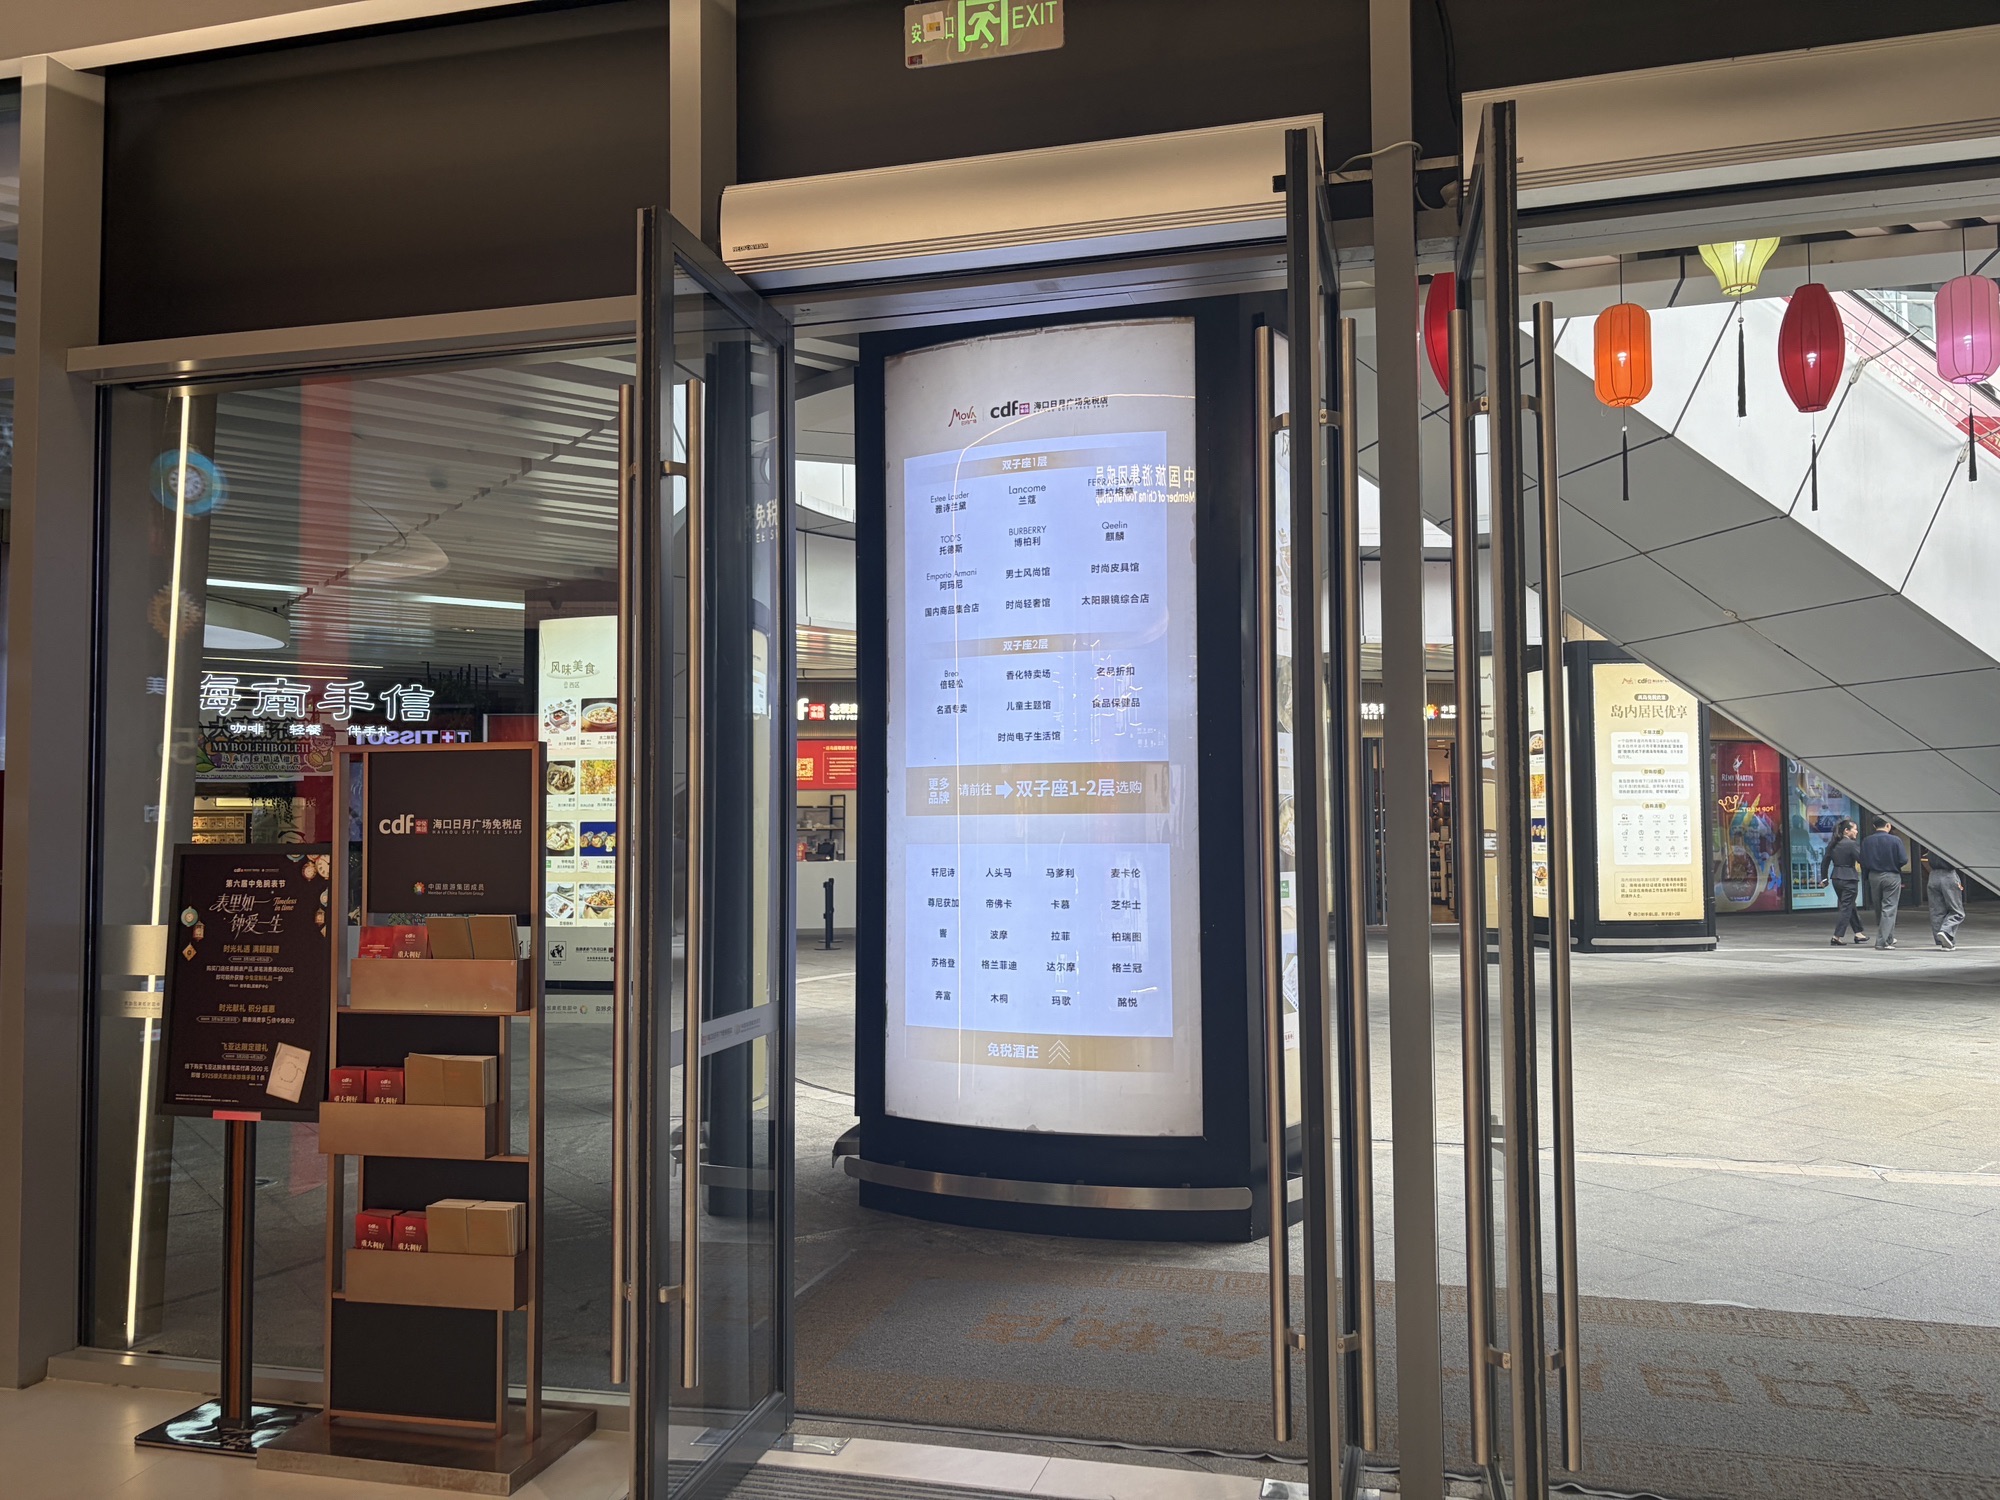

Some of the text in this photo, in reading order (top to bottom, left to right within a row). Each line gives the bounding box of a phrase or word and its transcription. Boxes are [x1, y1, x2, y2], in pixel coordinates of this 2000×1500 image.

[1012, 1, 1058, 29] EXIT
[912, 16, 955, 44] 安口
[990, 400, 1019, 419] cdf
[1002, 456, 1048, 471] 双子座1层
[1008, 484, 1047, 495] Lancome
[1018, 495, 1036, 505] 兰蔻
[935, 502, 967, 514] 雅诗兰黛
[1008, 525, 1047, 537] BURBERRY
[1101, 520, 1128, 531] Qeelin
[1014, 535, 1041, 547] 博柏利
[1105, 530, 1125, 542] 麒麟
[939, 544, 963, 555] 托德斯
[1005, 566, 1051, 579] 男士风尚馆
[1090, 562, 1140, 574] 时尚皮具馆
[926, 568, 977, 582] Emporio Armani
[939, 580, 963, 591] 阿玛尼
[1005, 597, 1051, 610] 时尚轻奢馆
[1081, 593, 1150, 606] 太阳眼镜综合店
[924, 602, 980, 617] 国内商品集合店
[1003, 639, 1048, 651] 双子座2层
[551, 660, 595, 675] 风味美食
[1096, 666, 1135, 677] 名品折扣
[1006, 669, 1051, 680] 香化特卖场
[939, 678, 964, 690] 倍轻松
[1006, 700, 1052, 711] 儿童主题馆
[1092, 697, 1141, 709] 食品保健品
[936, 704, 968, 715] 名酒专卖
[1610, 704, 1688, 719] 岛内居民优享
[230, 723, 264, 735] 咖啡
[289, 723, 322, 736] 轻餐
[346, 725, 391, 737] 伴手礼
[997, 731, 1061, 743] 时尚电子生活馆
[928, 777, 950, 791] 更多
[959, 782, 992, 797] 请前往
[1016, 778, 1143, 798] 双子座1-2层 选购
[928, 791, 950, 806] 品牌
[379, 814, 414, 834] cdf
[433, 819, 522, 830] 海口日月广场免税店
[931, 867, 956, 878] 轩尼诗
[985, 867, 1012, 879] 人头马
[1045, 867, 1075, 880] 马爹利
[1110, 867, 1141, 880] 麦卡伦
[226, 879, 286, 888] 第六届中免腕表节
[428, 883, 484, 891] 中国旅游集团成员
[209, 893, 271, 913] 表里如一
[273, 896, 297, 906] Timeless
[927, 898, 960, 908] 尊尼获加
[1050, 899, 1070, 910] 卡慕
[1110, 899, 1142, 911] 芝华士
[229, 913, 284, 940] 钟爱一生
[990, 930, 1008, 941] 波摩
[1051, 931, 1071, 942] 拉菲
[1111, 932, 1142, 943] 柏瑞图
[931, 958, 956, 969] 苏格登
[981, 960, 1018, 971] 格兰菲迪
[1046, 961, 1076, 973] 达尔摩
[1111, 962, 1143, 974] 格兰冠
[935, 990, 952, 1001] 奔富
[1051, 996, 1072, 1007] 玛歌
[1117, 997, 1138, 1008] 酩悦
[987, 1042, 1039, 1060] 免税酒庄
